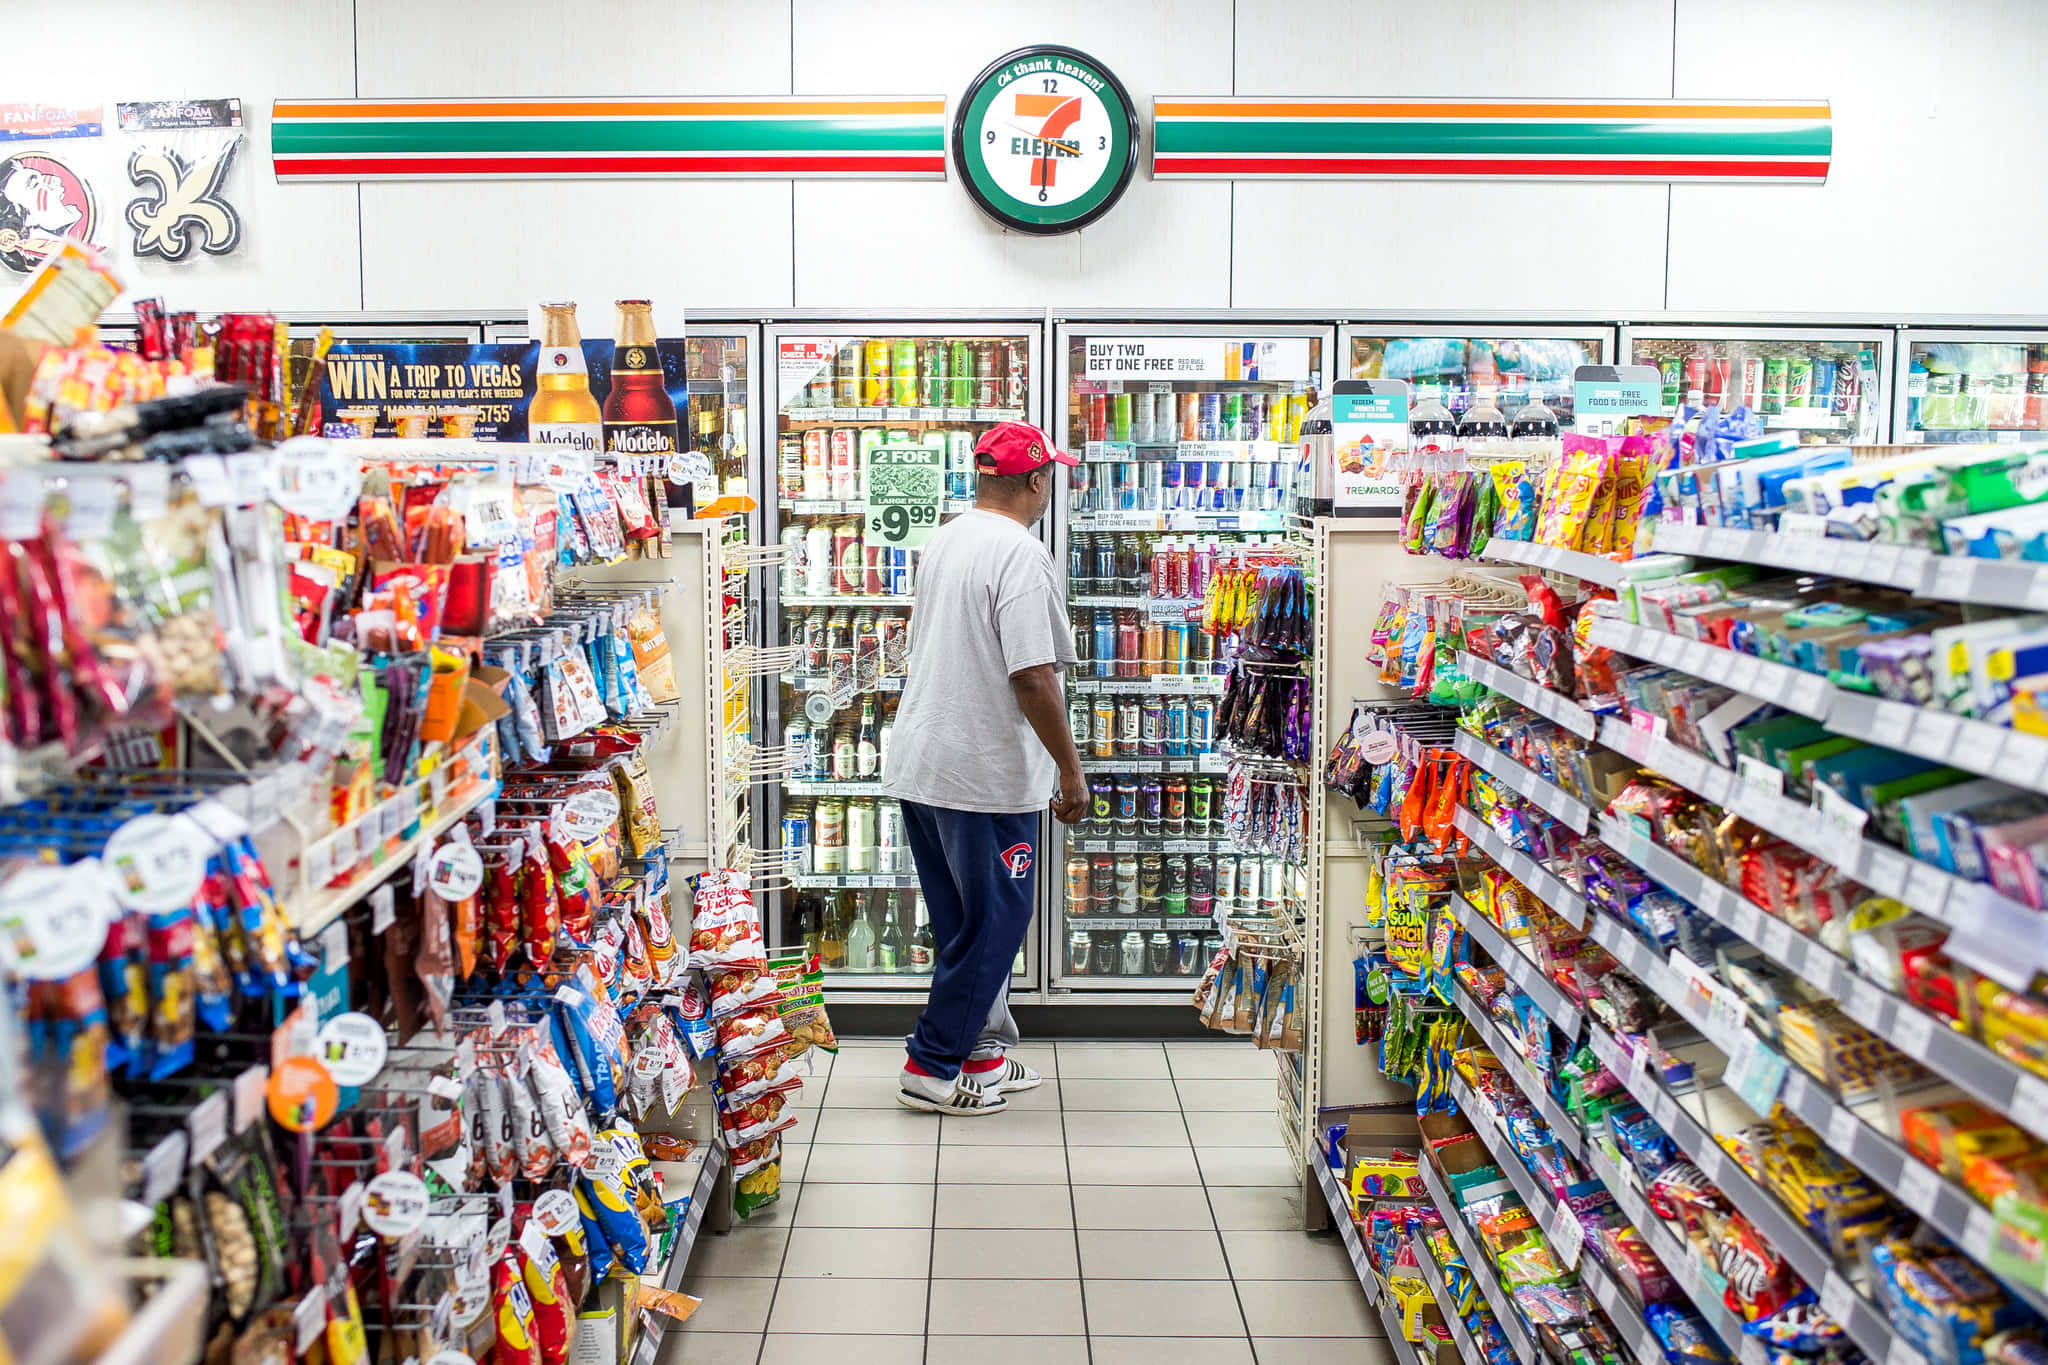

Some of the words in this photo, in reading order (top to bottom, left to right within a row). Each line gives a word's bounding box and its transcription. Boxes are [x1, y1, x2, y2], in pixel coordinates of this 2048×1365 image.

[1014, 58, 1053, 77] thank
[1042, 79, 1058, 93] 12
[150, 105, 212, 119] FANFOAM
[986, 131, 996, 144] 9
[1098, 136, 1106, 150] 3
[1038, 189, 1047, 202] 6
[1090, 344, 1113, 356] BUY
[1117, 344, 1145, 356] TWO
[1090, 359, 1112, 371] GET
[1116, 359, 1140, 371] ONE
[1144, 359, 1174, 371] FREE
[328, 361, 387, 400] WIN
[390, 365, 401, 387] A
[404, 365, 440, 388] TRIP
[444, 365, 466, 388] TO
[470, 364, 522, 388] VEGAS
[390, 389, 403, 399] FOR
[404, 389, 417, 399] UFC
[418, 389, 431, 399] 232
[431, 389, 441, 399] ON
[1620, 399, 1648, 407] DRINKS
[613, 430, 669, 452] Modelo
[875, 451, 888, 463] 2
[892, 451, 931, 463] FOR
[1390, 926, 1422, 942] PATCH
